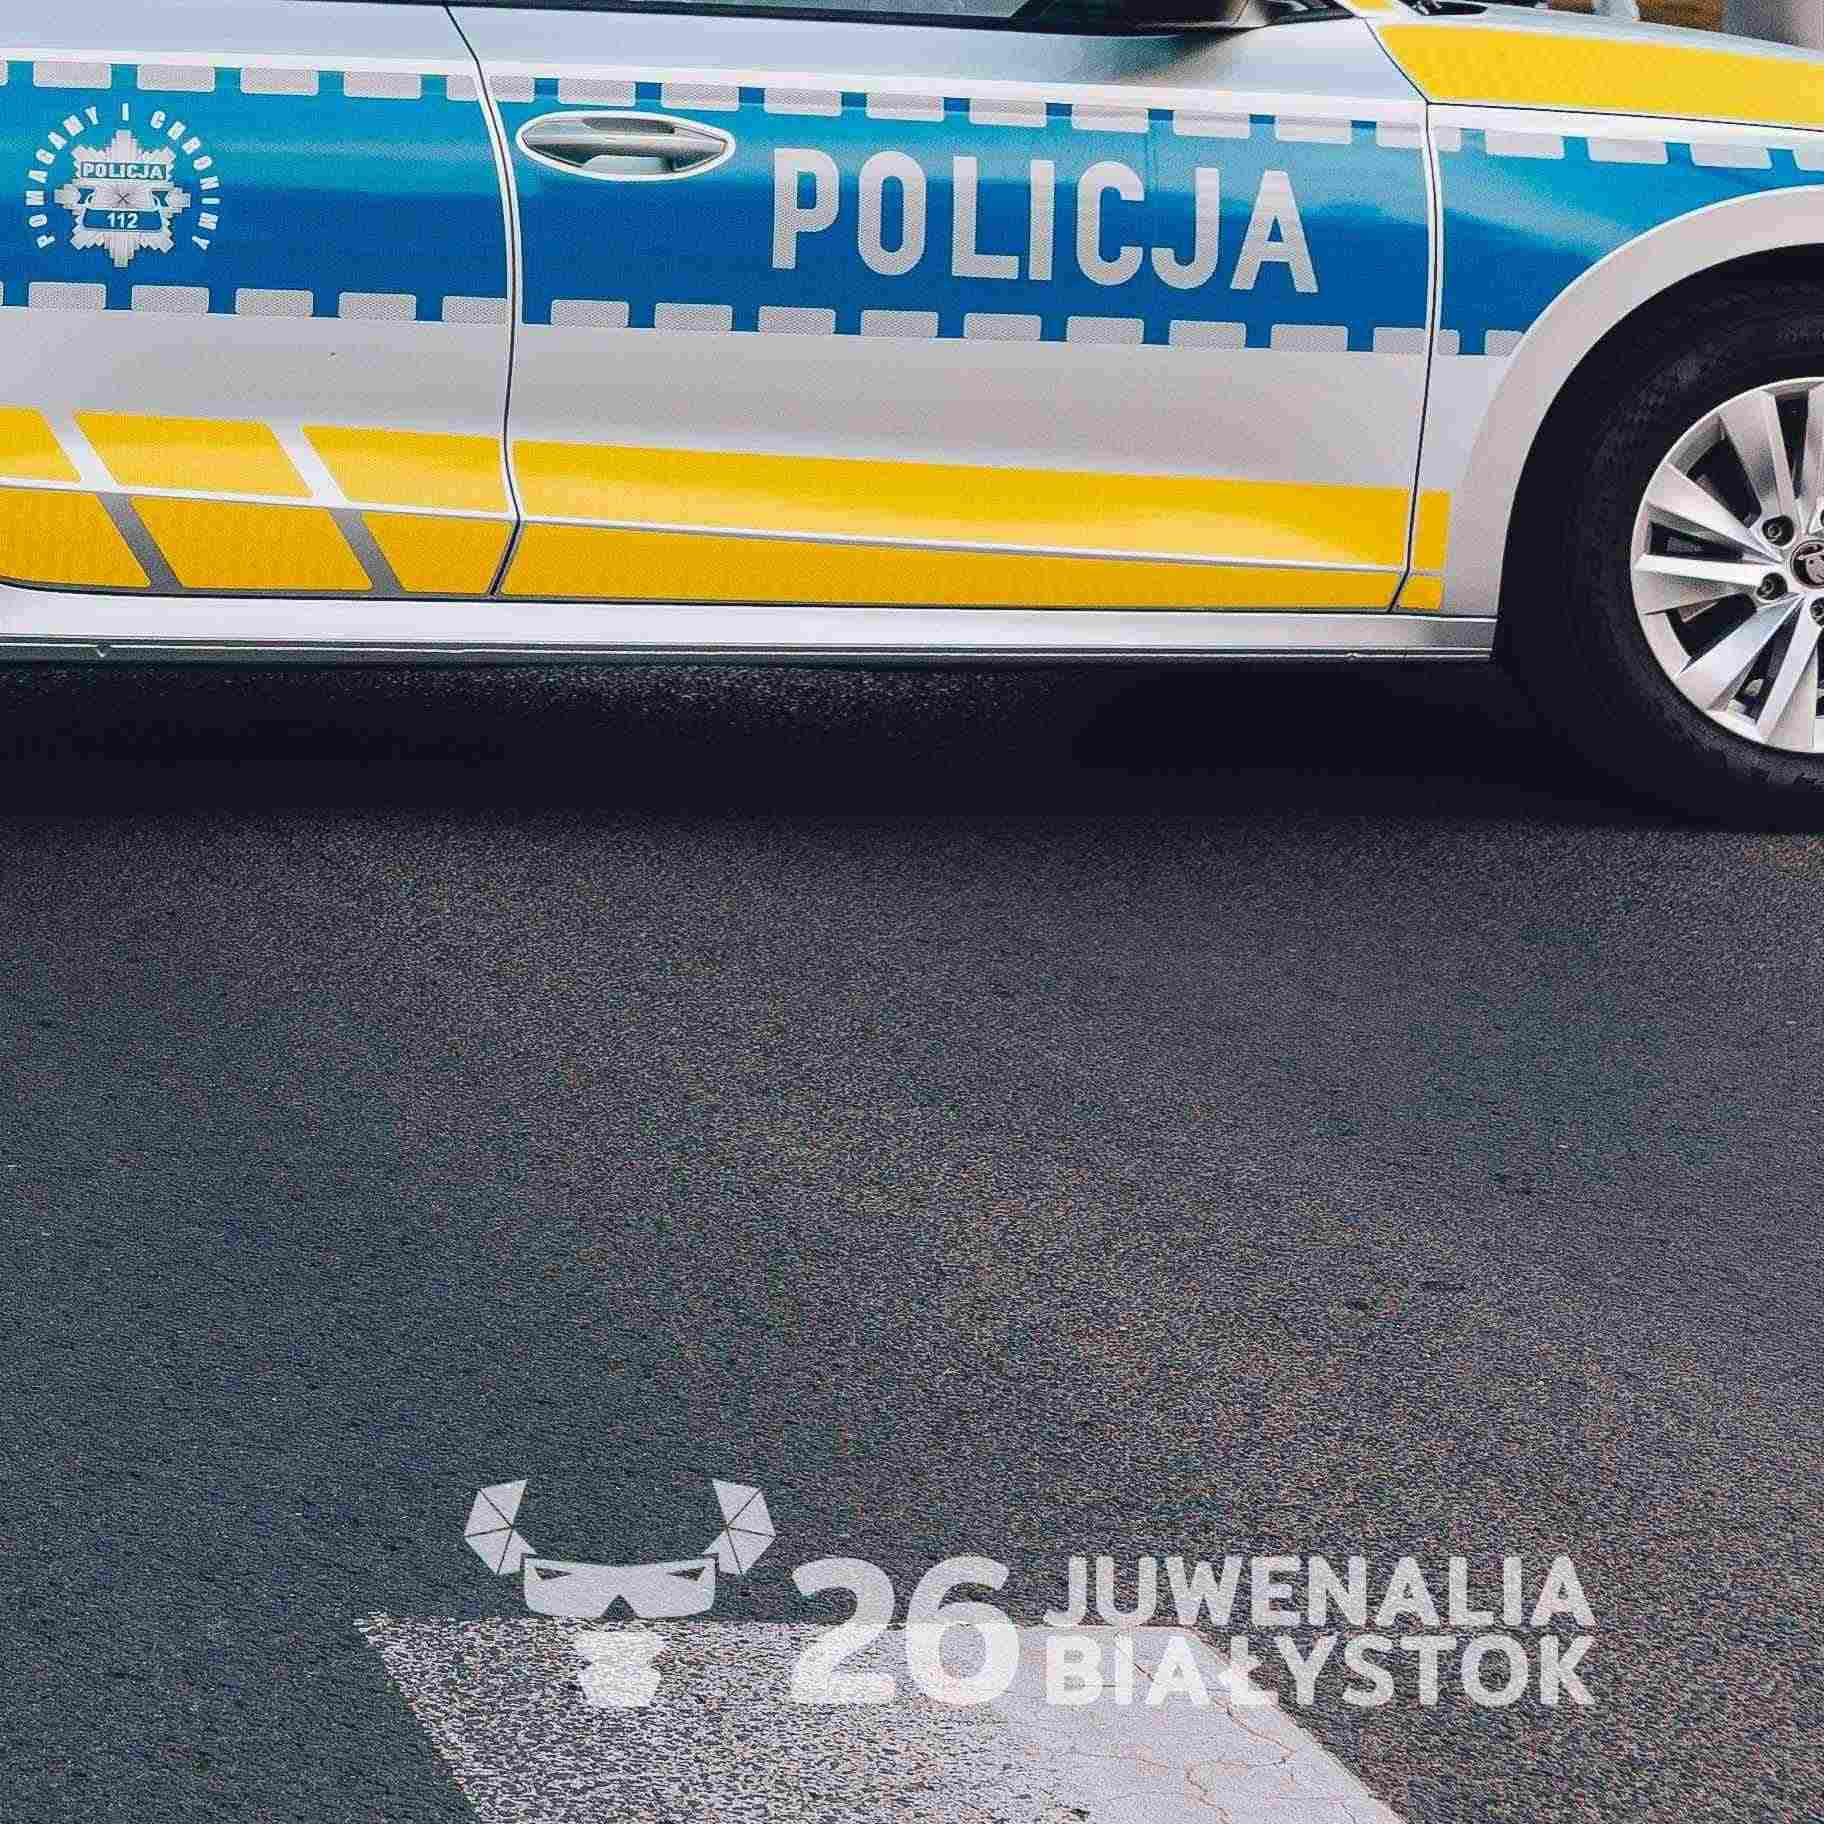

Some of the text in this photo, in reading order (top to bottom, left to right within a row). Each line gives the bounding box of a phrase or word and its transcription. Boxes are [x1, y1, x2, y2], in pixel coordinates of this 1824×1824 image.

[24, 106, 100, 249] POMAGAMY
[150, 110, 222, 251] CHRONIMY
[81, 161, 166, 180] POLICJA
[106, 212, 139, 229] 112
[772, 147, 1319, 294] POLICJA
